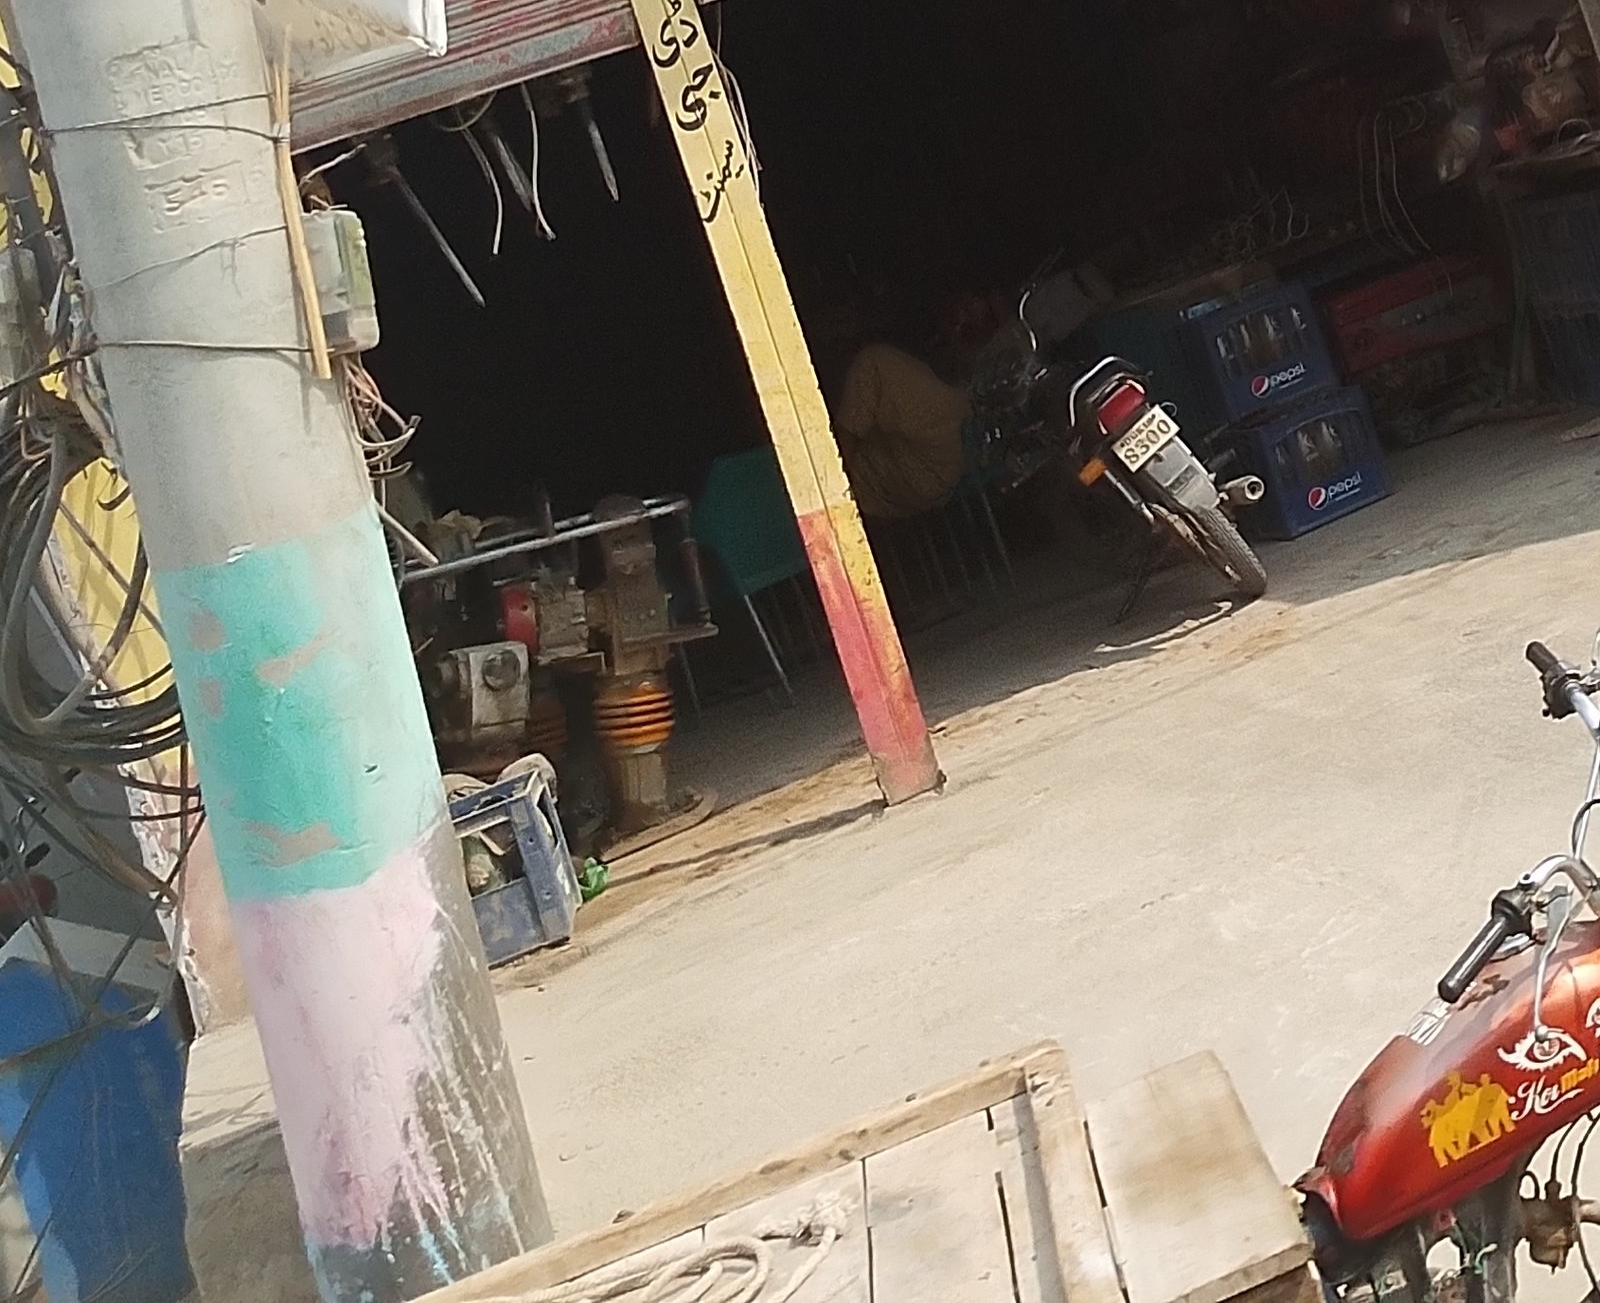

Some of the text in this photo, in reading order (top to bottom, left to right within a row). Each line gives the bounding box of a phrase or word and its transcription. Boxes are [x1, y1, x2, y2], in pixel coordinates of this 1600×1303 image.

[675, 63, 721, 131] جی
[1270, 362, 1306, 388] pepsi
[1124, 419, 1171, 464] 8300
[1327, 471, 1363, 499] pepsi
